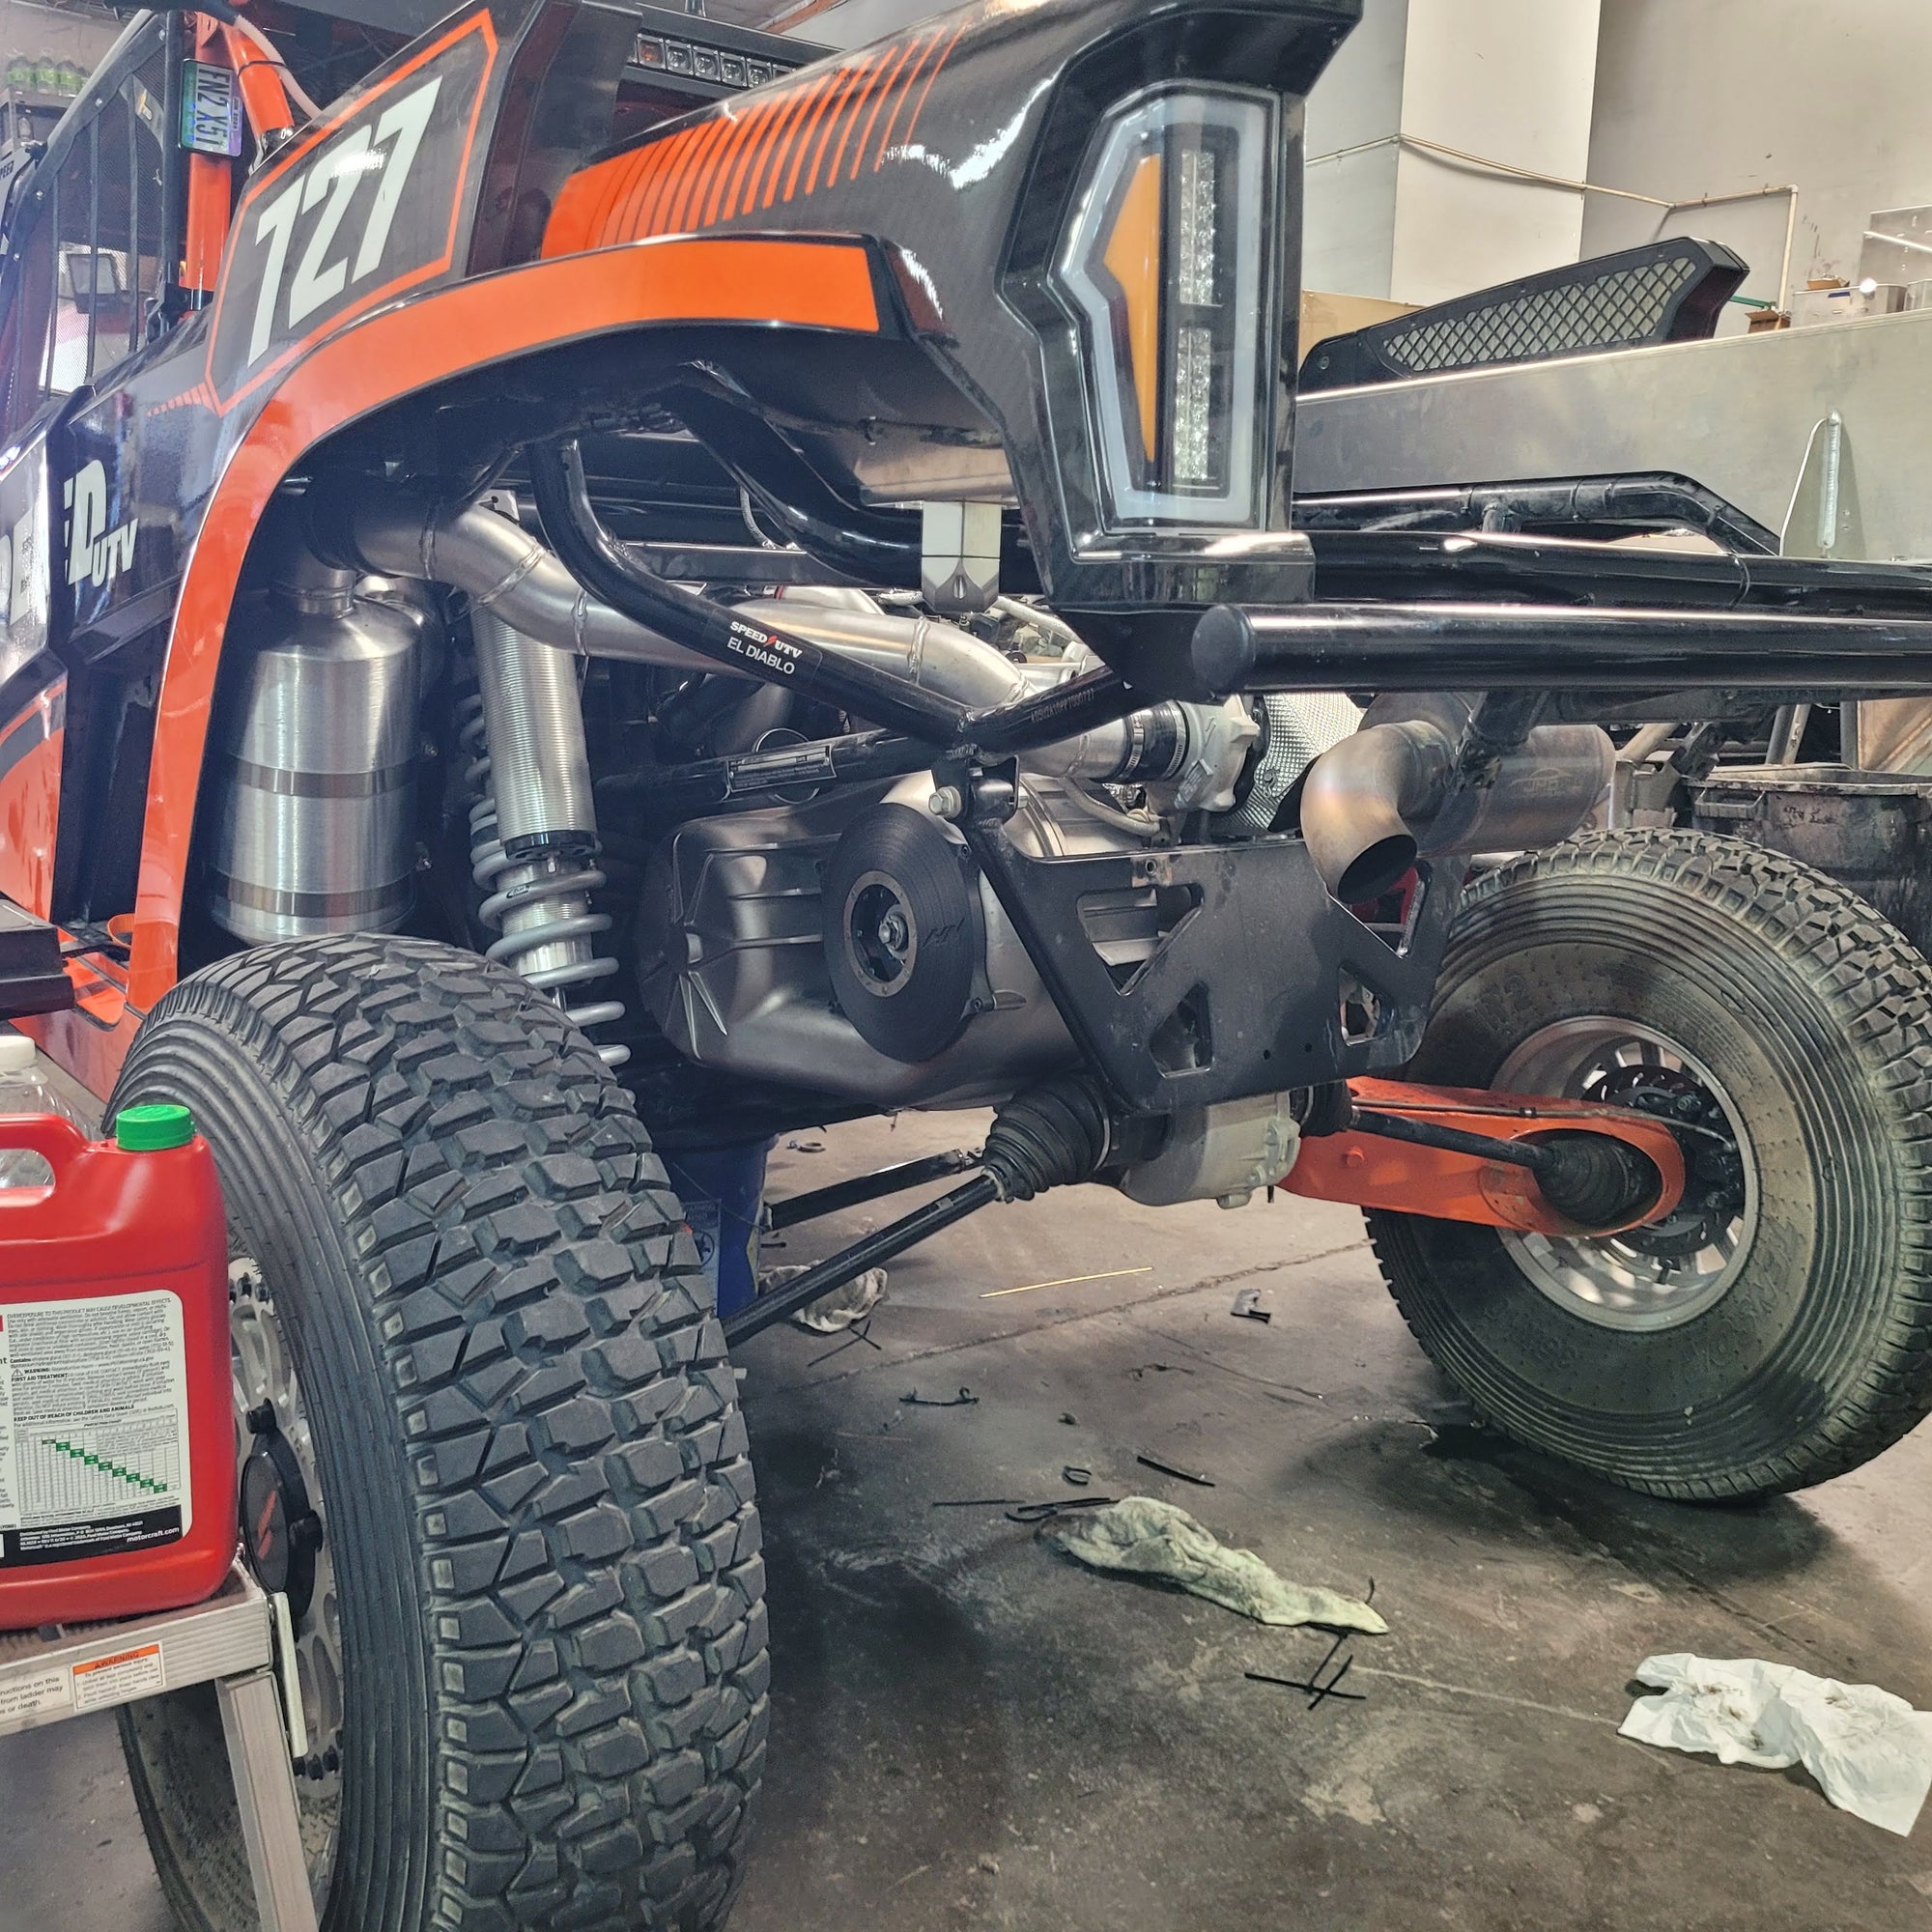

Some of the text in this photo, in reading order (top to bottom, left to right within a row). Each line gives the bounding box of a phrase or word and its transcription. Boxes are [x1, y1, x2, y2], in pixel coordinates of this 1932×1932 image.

[247, 75, 443, 369] 727
[92, 518, 138, 587] UTV
[726, 637, 795, 674] EL DIABLO
[729, 620, 803, 659] SPEED UTV
[127, 1527, 180, 1543] motorcraft.com
[20, 1690, 44, 1700] ladder
